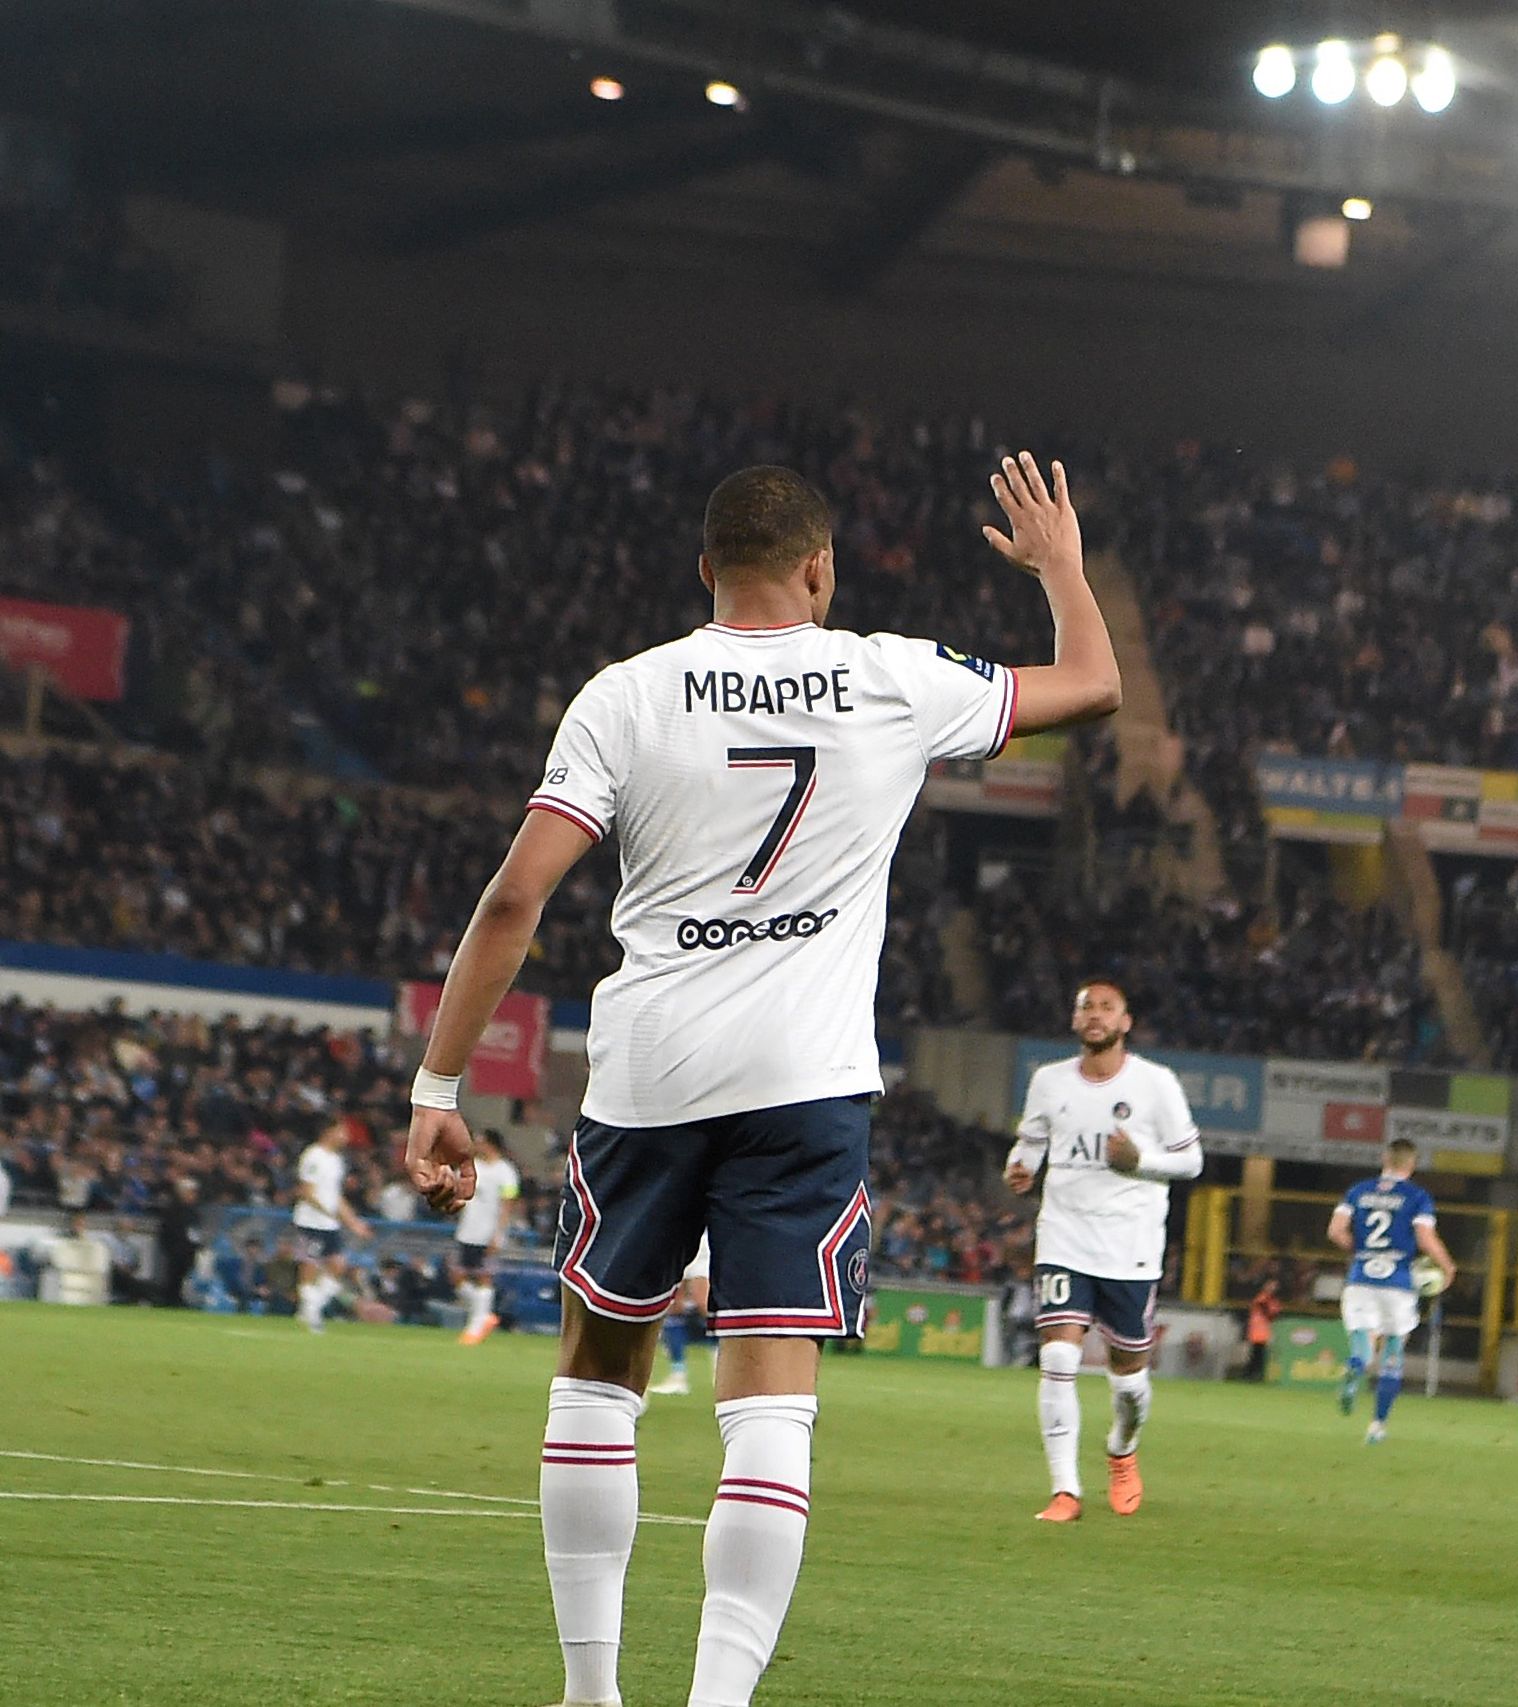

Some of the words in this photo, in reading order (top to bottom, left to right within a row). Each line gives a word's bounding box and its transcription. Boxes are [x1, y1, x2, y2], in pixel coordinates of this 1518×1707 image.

[684, 663, 854, 715] MBAPPÉ
[727, 746, 816, 894] 7
[1364, 1209, 1392, 1249] 2
[1041, 1273, 1071, 1306] 10
